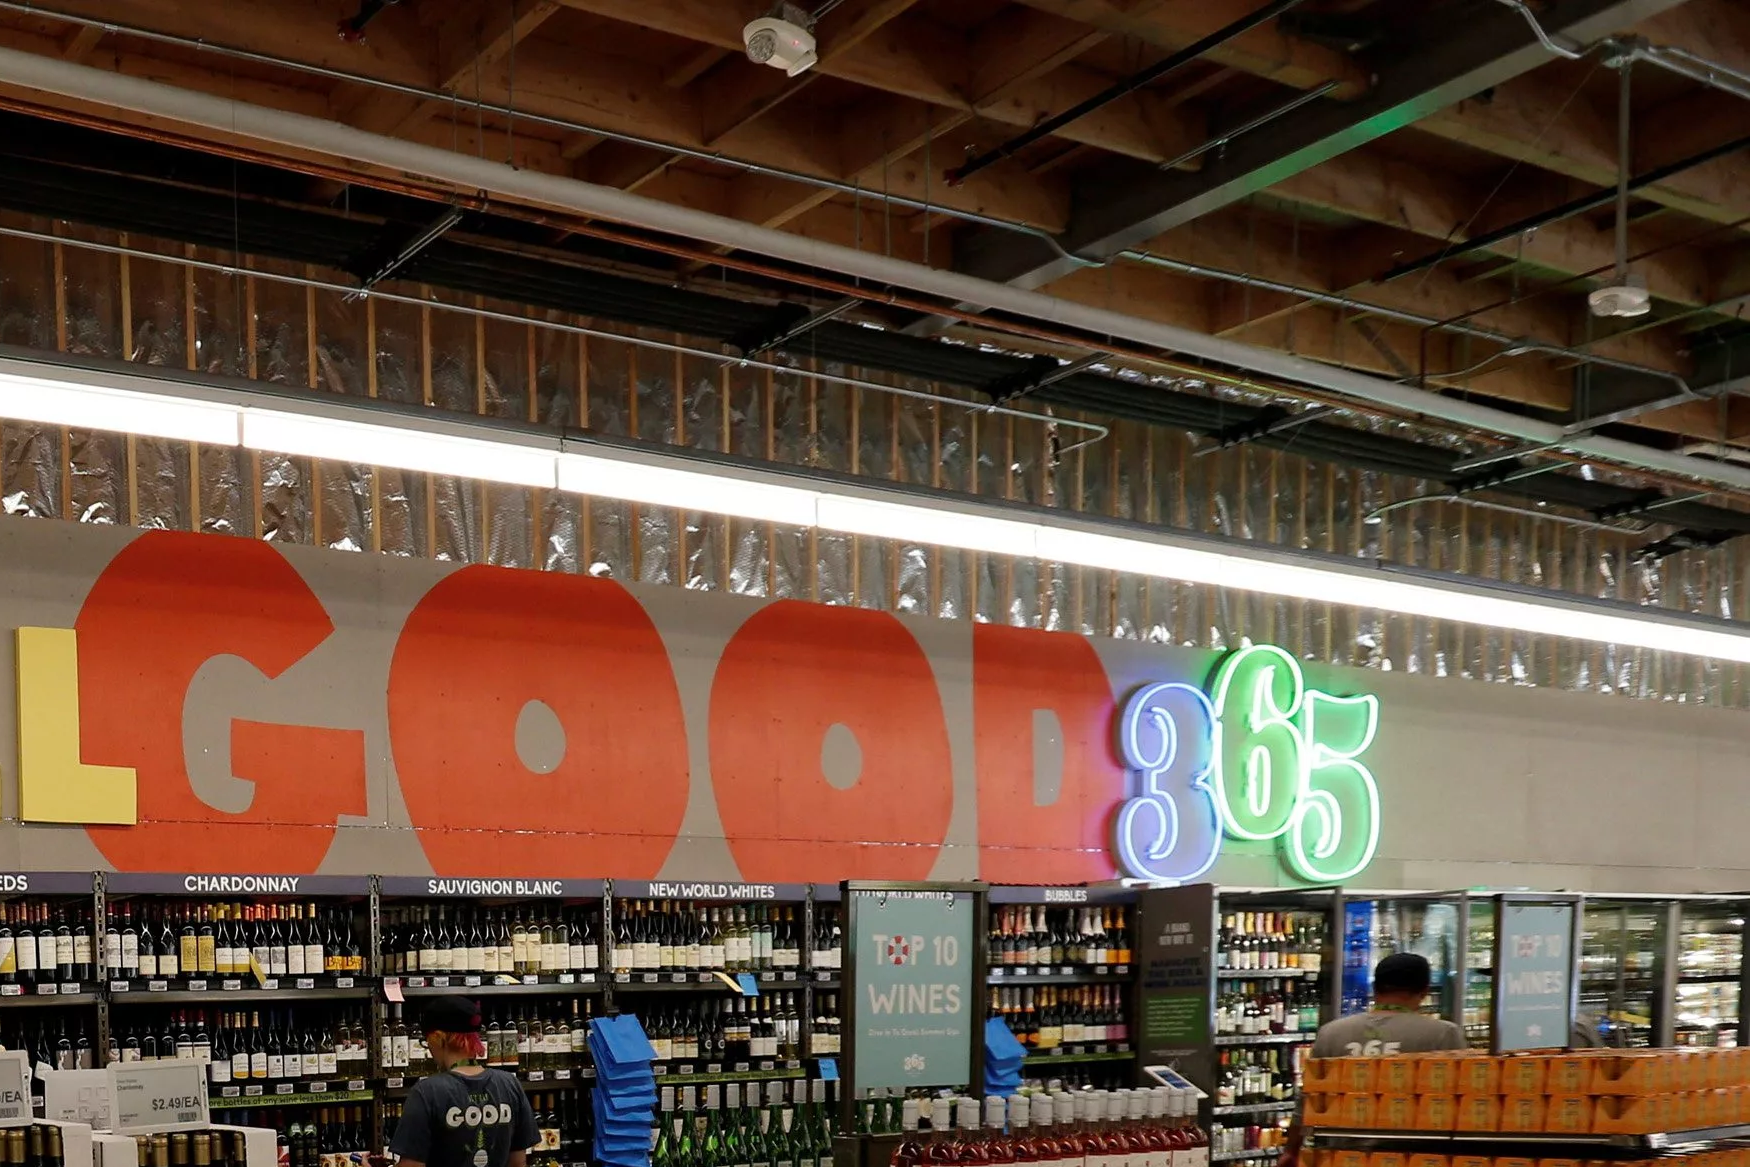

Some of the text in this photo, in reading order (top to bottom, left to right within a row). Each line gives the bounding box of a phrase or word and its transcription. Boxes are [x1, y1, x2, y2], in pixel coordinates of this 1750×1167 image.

[74, 530, 1116, 881] GOOD
[1117, 642, 1379, 882] 365
[184, 876, 299, 893] CHARDONNAY
[428, 879, 562, 895] SAUVIGNON BLANC
[649, 882, 775, 898] NEW WORLD WHITES
[1045, 889, 1087, 903] BUBBLES
[871, 934, 958, 966] TOP 10
[868, 984, 961, 1015] WINES
[152, 1097, 200, 1111] $2.49/EA
[225, 1096, 250, 1106] bottles
[264, 1097, 278, 1106] any
[280, 1095, 298, 1103] wine
[300, 1094, 313, 1102] less
[315, 1093, 333, 1102] than
[335, 1091, 349, 1101] $20
[445, 1103, 511, 1127] GOOD
